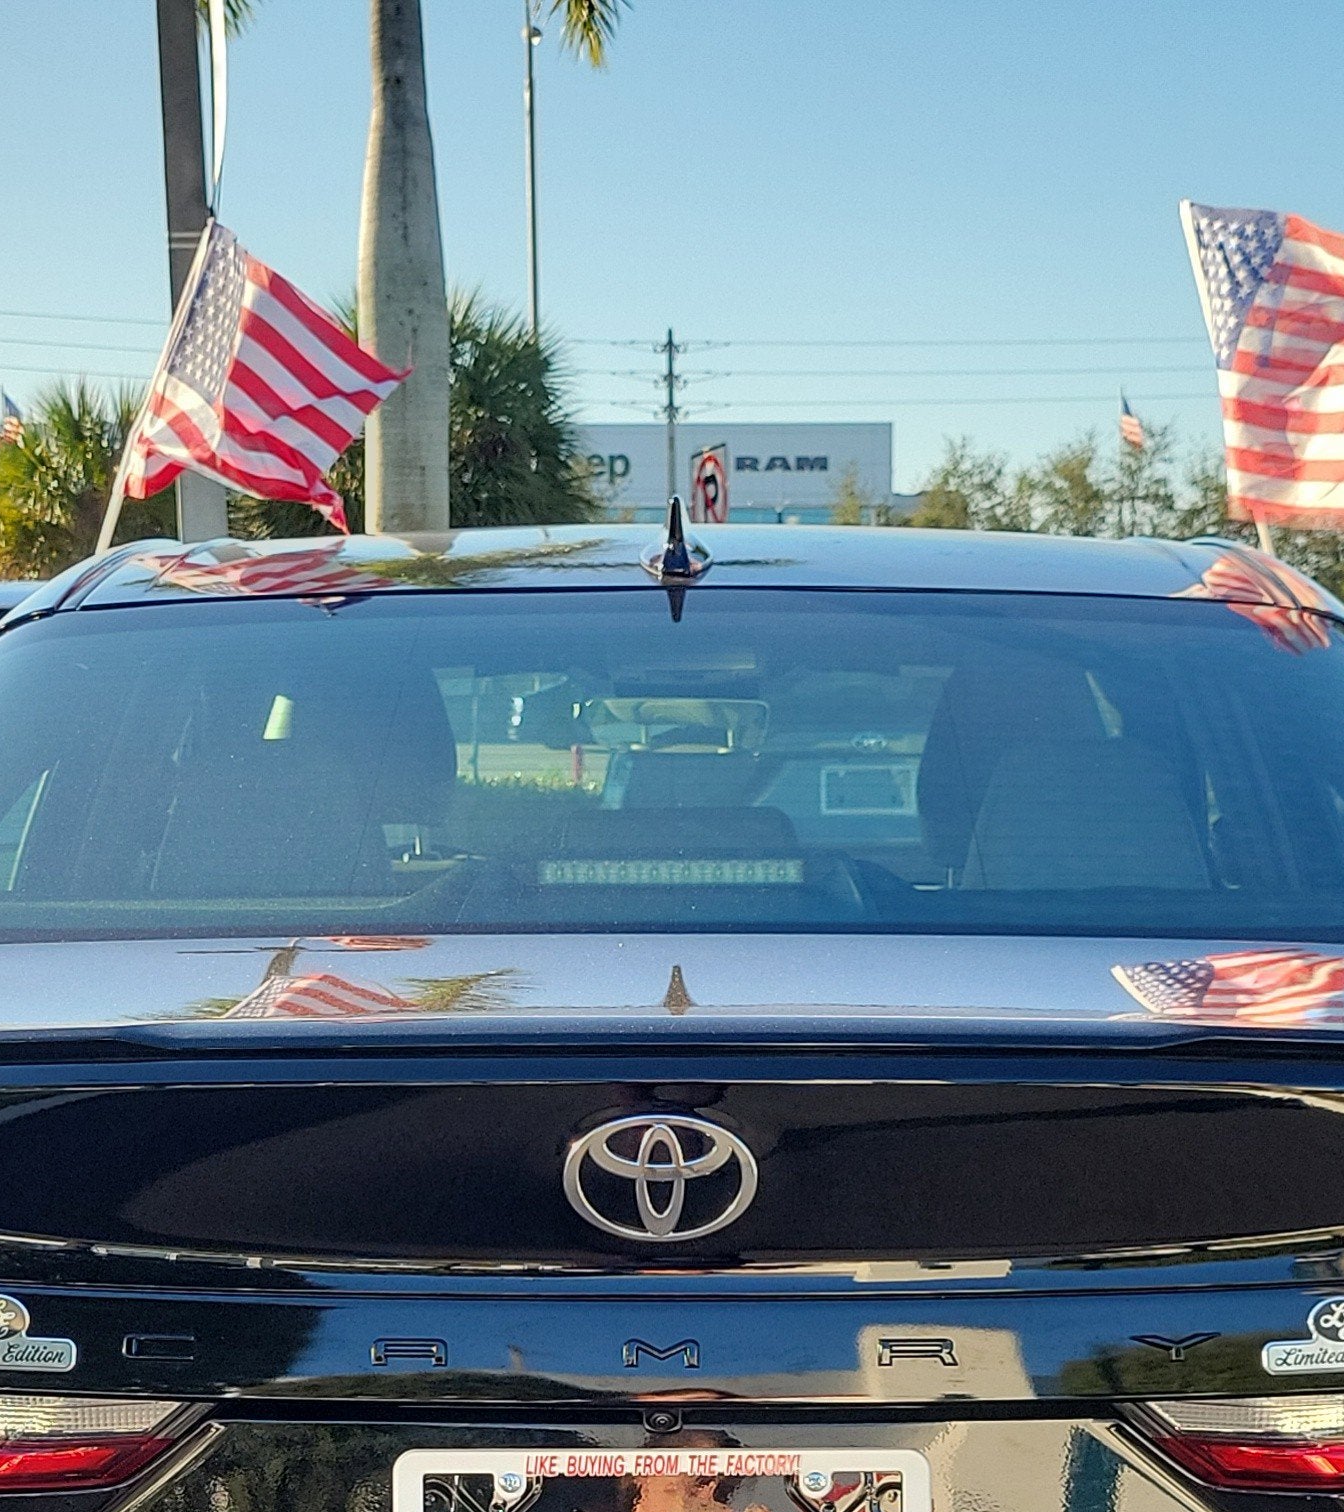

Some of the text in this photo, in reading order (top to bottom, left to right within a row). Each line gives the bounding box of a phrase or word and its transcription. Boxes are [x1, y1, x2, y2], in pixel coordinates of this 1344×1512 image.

[735, 456, 829, 472] RAM
[1, 1341, 67, 1364] Edition
[121, 1331, 1221, 1369] CAMRY
[525, 1453, 802, 1476] LIKE BUYING FROM THE FACTORY!
